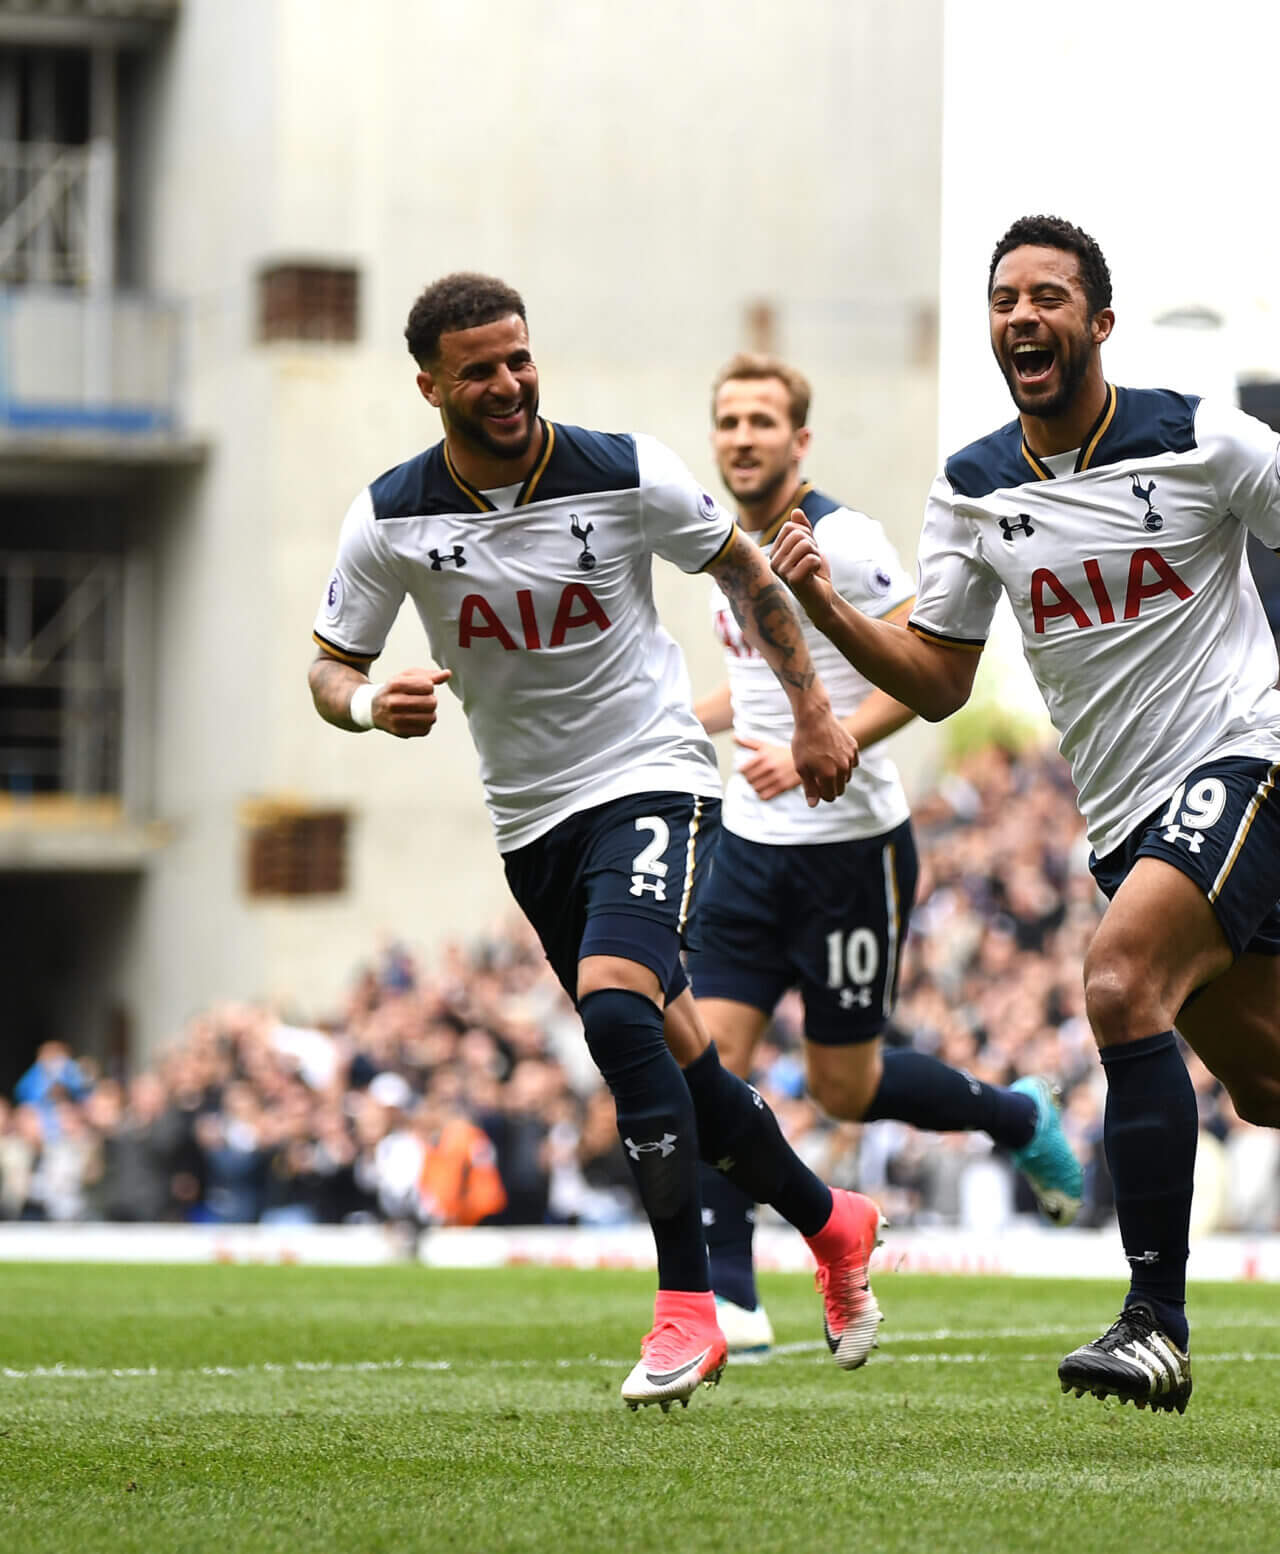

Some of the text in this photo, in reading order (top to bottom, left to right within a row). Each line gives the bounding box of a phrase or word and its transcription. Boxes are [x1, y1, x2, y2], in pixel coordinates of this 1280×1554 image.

[458, 583, 612, 650] AIA
[1030, 547, 1195, 634] AIA
[1159, 777, 1227, 830] 19
[632, 815, 670, 878] 2
[826, 927, 880, 989] 10
